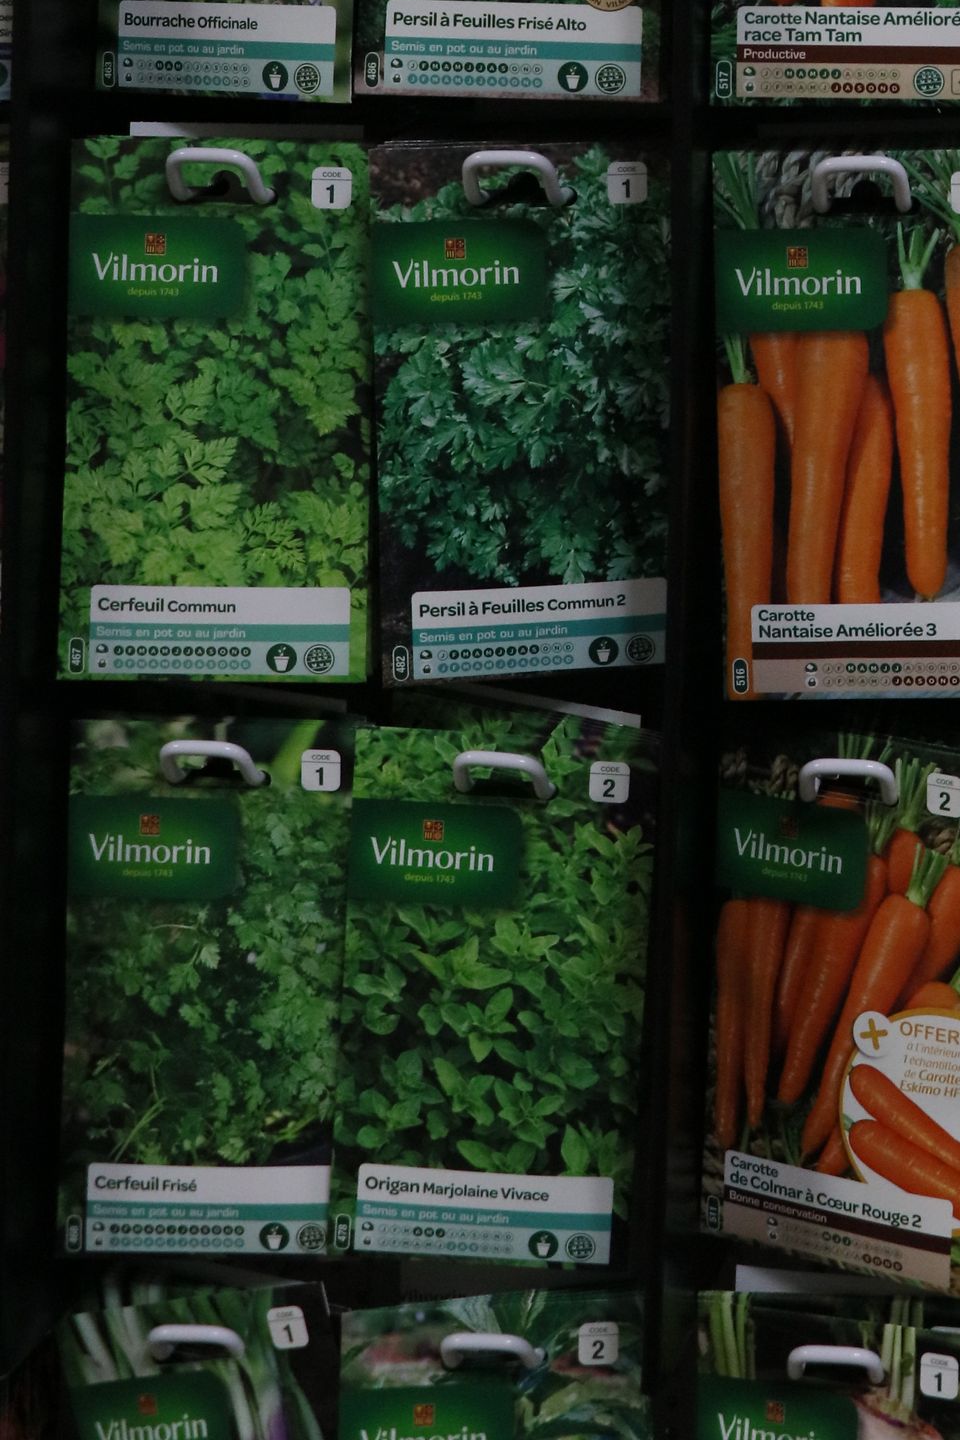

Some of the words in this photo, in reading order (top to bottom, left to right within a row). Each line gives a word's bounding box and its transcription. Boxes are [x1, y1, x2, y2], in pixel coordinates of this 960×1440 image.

[124, 13, 195, 28] Bourrache
[198, 17, 258, 30] Officinale
[393, 12, 437, 26] Persil
[441, 12, 449, 27] à
[453, 14, 514, 28] Feuilles
[519, 17, 553, 30] Frisé
[556, 18, 586, 31] Alto
[745, 12, 801, 25] Carotte
[805, 11, 880, 26] Nantaise
[744, 30, 781, 41] race
[784, 29, 822, 41] Tam
[825, 29, 861, 42] Tam
[744, 49, 806, 60] Productive
[92, 252, 218, 282] Vilmorin
[392, 259, 519, 288] Vilmorin
[735, 267, 861, 296] Vilmorin
[98, 598, 163, 611] Cerfeuil
[168, 601, 236, 613] Commun
[420, 603, 466, 617] Persil
[469, 602, 478, 616] à
[482, 598, 543, 615] Feuilles
[548, 598, 614, 610] Commun
[617, 594, 626, 605] 2
[758, 610, 815, 622] Carotte
[759, 624, 833, 638] Nantaise
[836, 622, 923, 638] Améliorée
[926, 623, 936, 636] 3
[89, 832, 211, 864] Vilmorin
[370, 836, 494, 872] Vilmorin
[734, 828, 842, 874] Vilmorin
[731, 1156, 778, 1177] Carotte
[95, 1176, 159, 1191] Cerfeuil
[163, 1179, 197, 1192] Frisé
[366, 1176, 420, 1195] Origan
[423, 1183, 498, 1199] Marjolaine
[501, 1188, 549, 1201] Vivace
[730, 1170, 747, 1187] de
[750, 1176, 803, 1199] Colmar
[806, 1186, 814, 1202] à
[817, 1193, 858, 1214] Cœur
[862, 1204, 909, 1226] Rouge
[912, 1215, 921, 1227] 2
